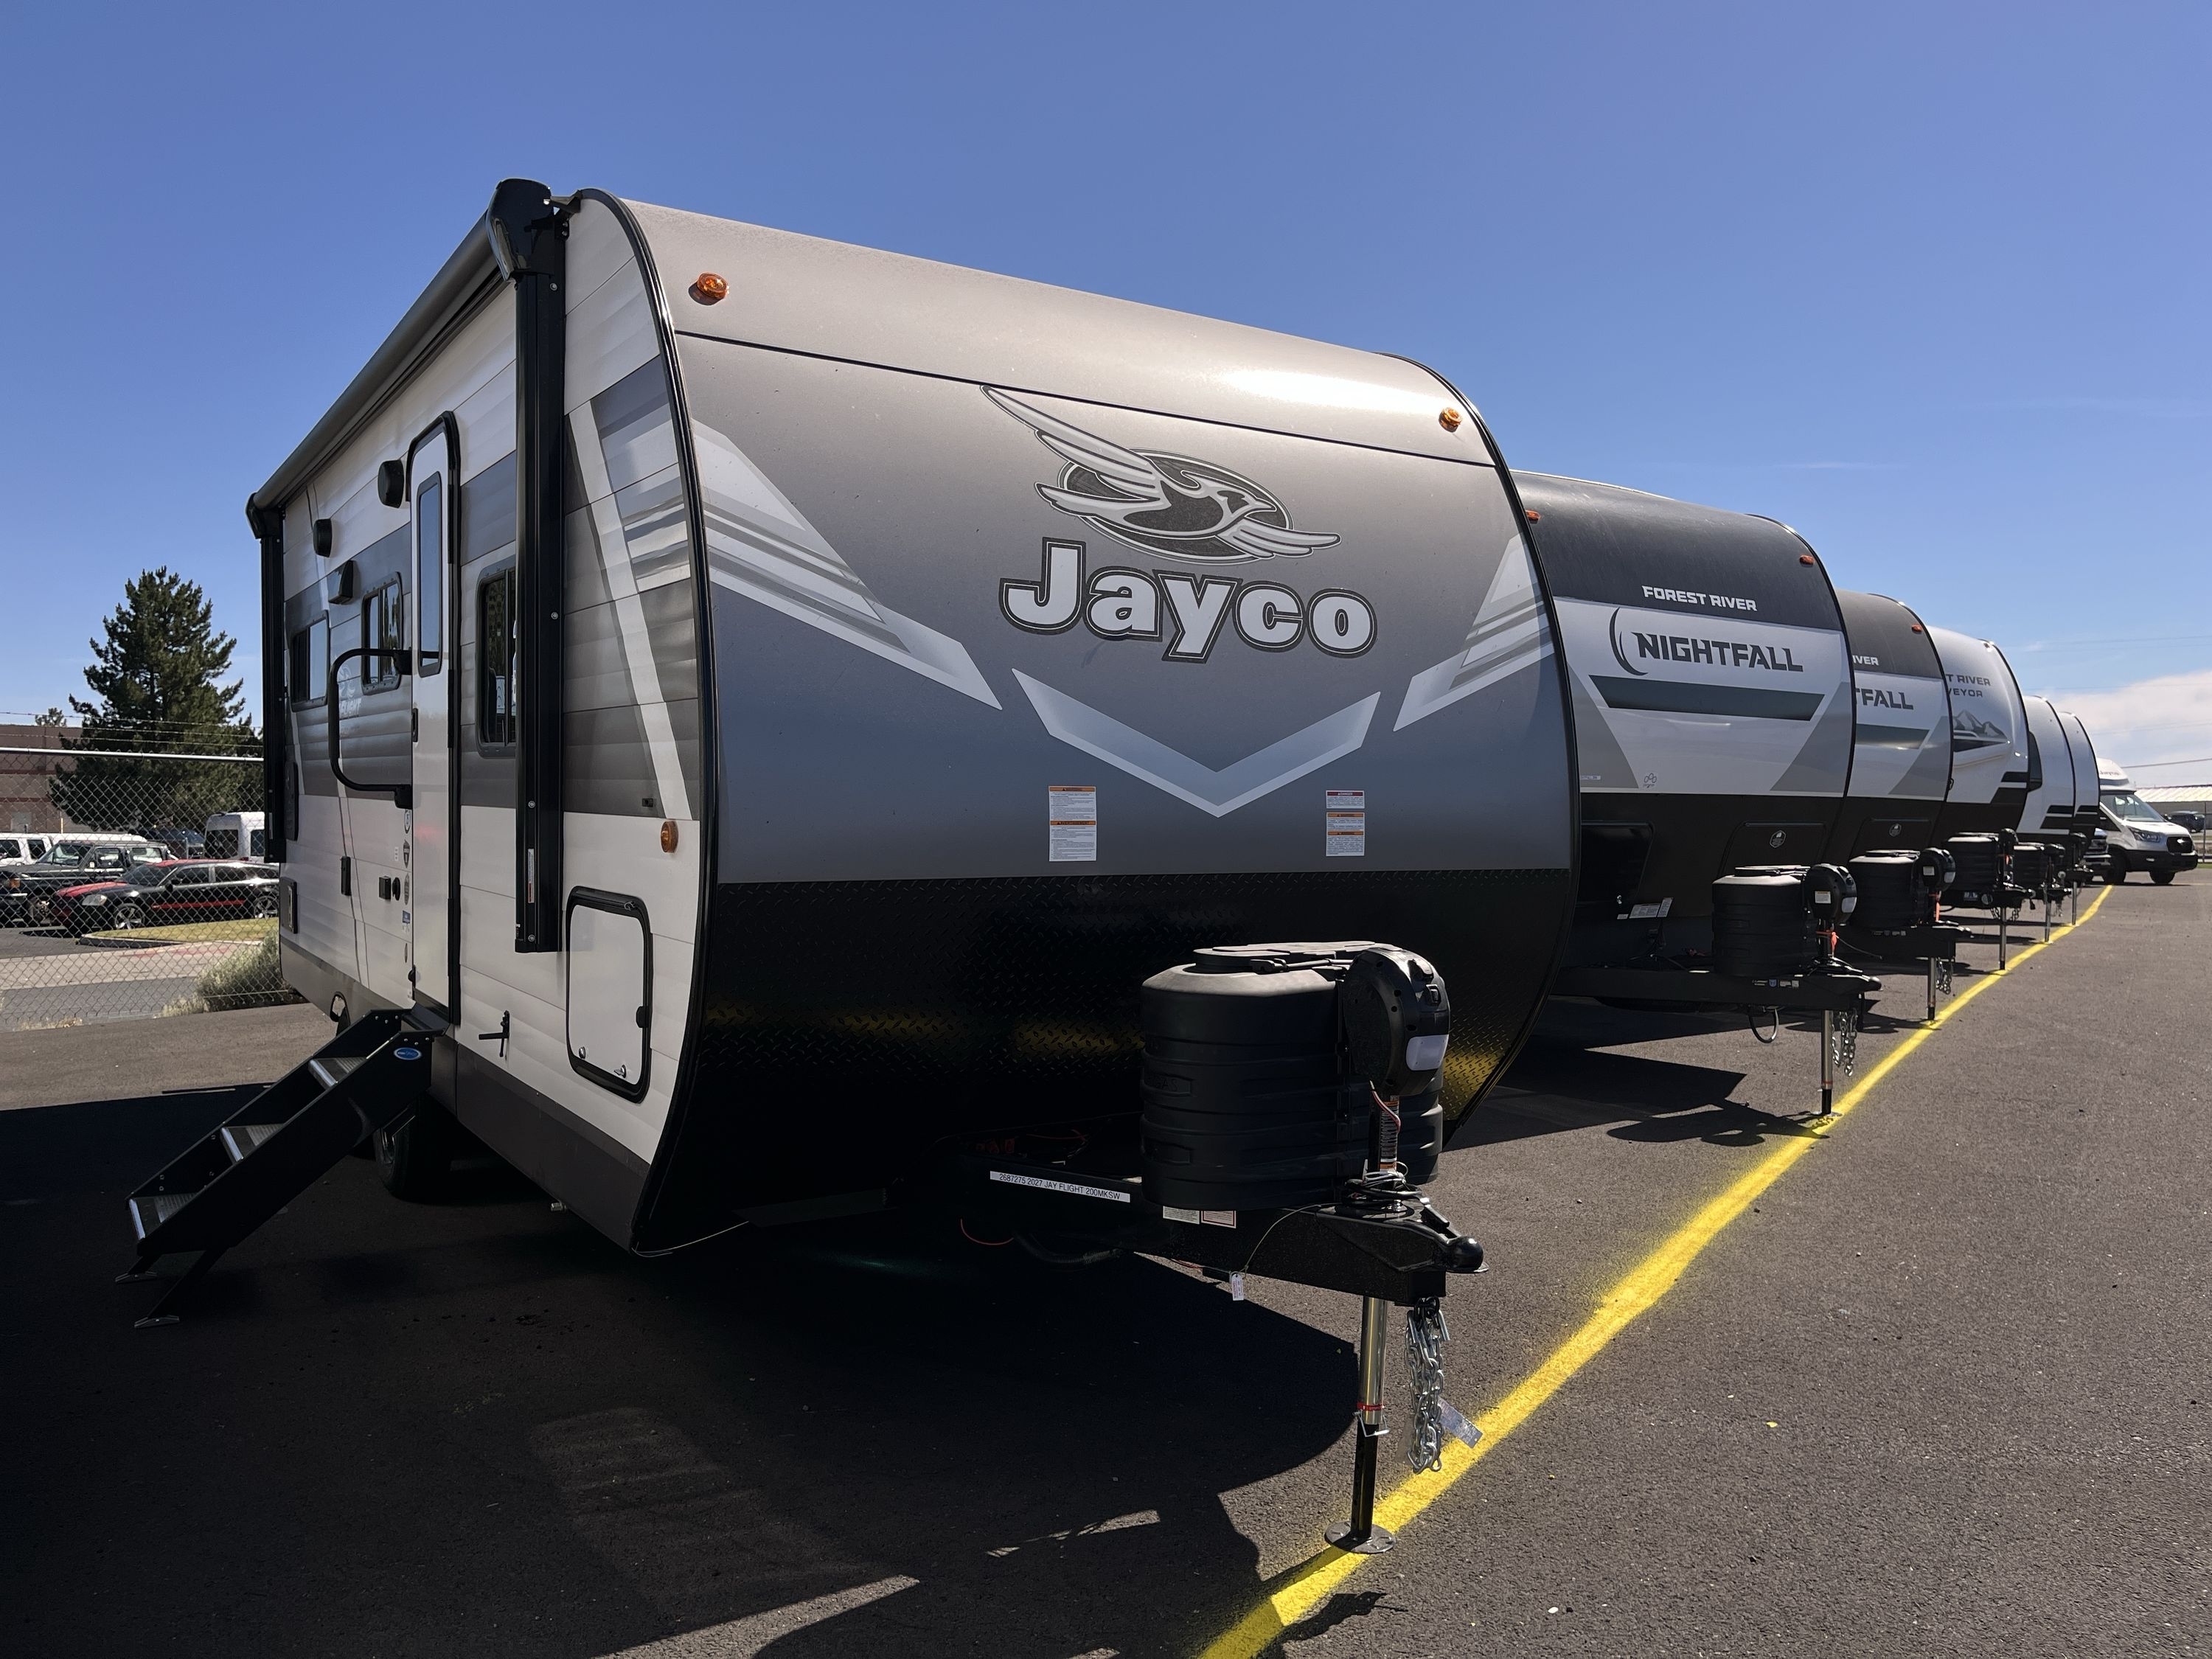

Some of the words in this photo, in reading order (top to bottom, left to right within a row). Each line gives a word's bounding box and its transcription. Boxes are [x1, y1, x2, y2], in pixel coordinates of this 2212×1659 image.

[999, 538, 1377, 662] Jayco
[1641, 585, 1706, 605] FOREST
[1709, 594, 1758, 611] RIVER
[1631, 632, 1804, 672] NIGHTFALL
[1852, 655, 1879, 666] IVER
[1956, 675, 1991, 686] RIVER
[999, 1173, 1026, 1184] 2687275
[1027, 1178, 1043, 1187] 2027
[1044, 1181, 1057, 1190] JAY
[1059, 1183, 1084, 1194] FLIGHT
[1085, 1188, 1121, 1200] 200MKSW
